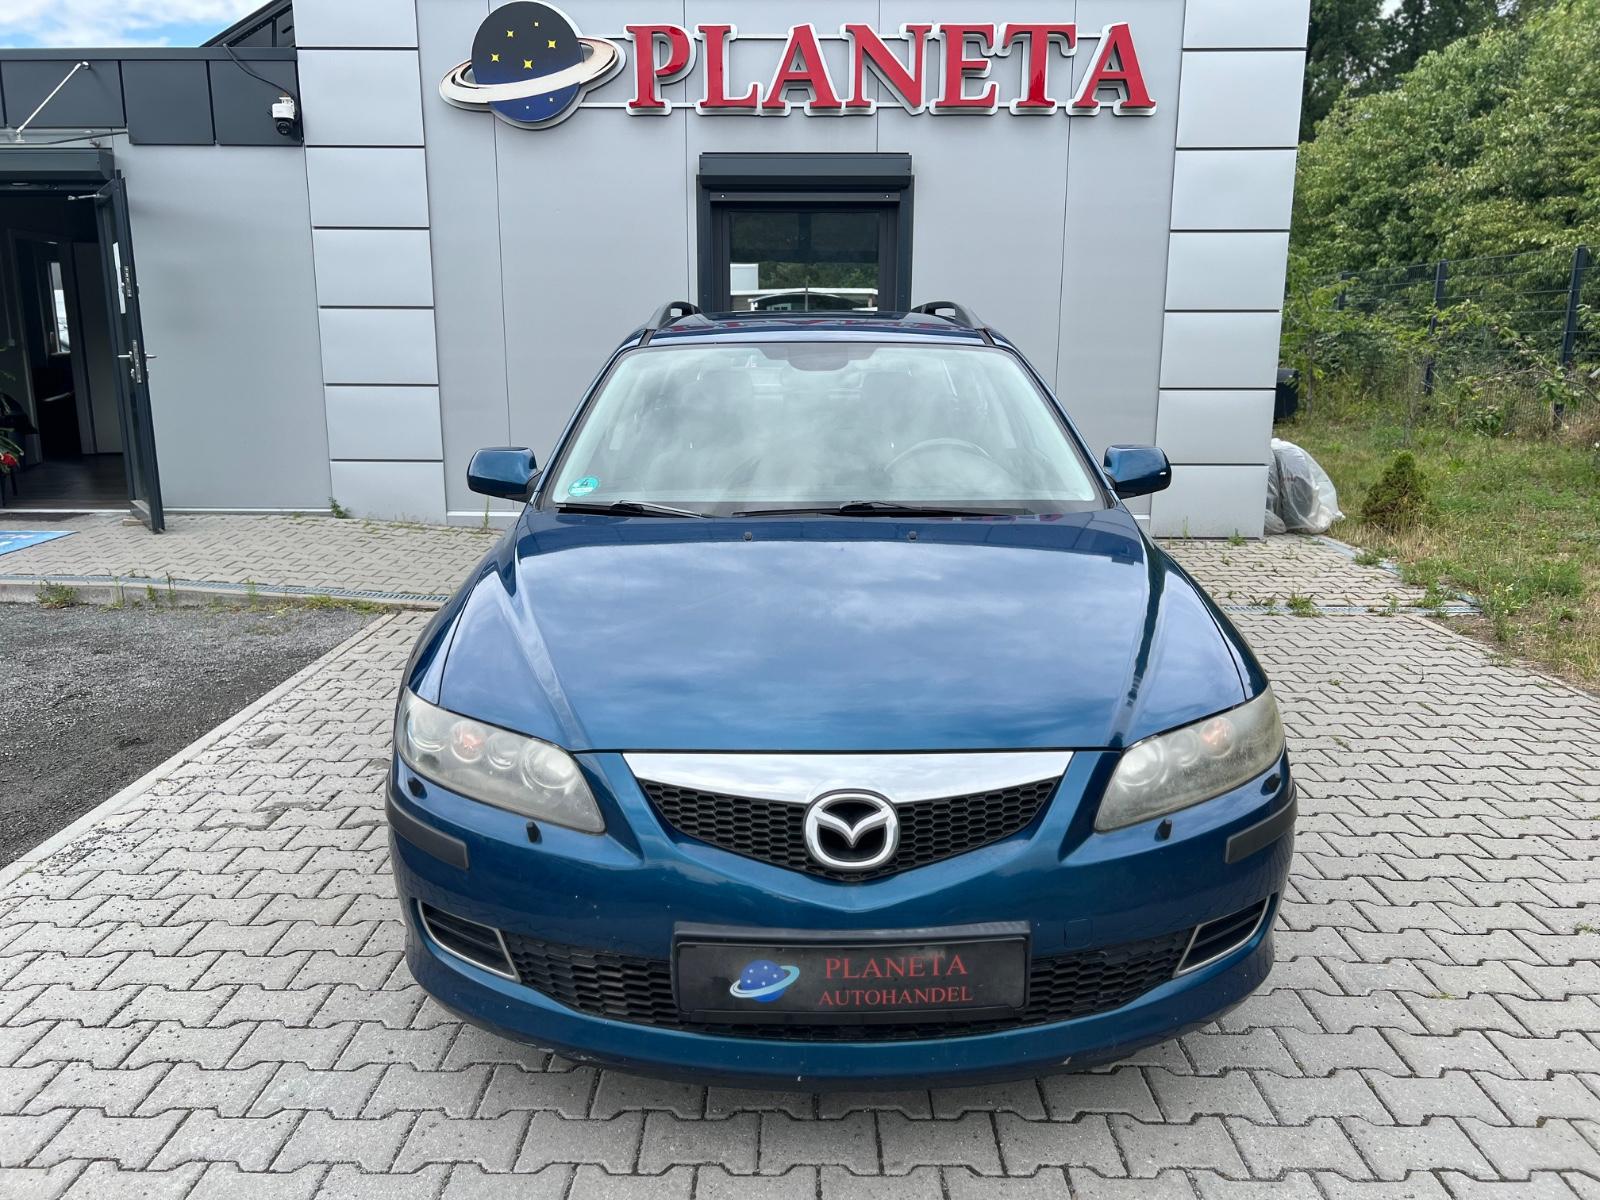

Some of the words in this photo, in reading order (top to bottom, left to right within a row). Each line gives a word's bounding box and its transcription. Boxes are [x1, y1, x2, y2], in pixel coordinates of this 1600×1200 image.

[626, 23, 1156, 115] PLANETA
[825, 954, 968, 980] PLANETA
[820, 986, 973, 1006] AUTOHANDEL
